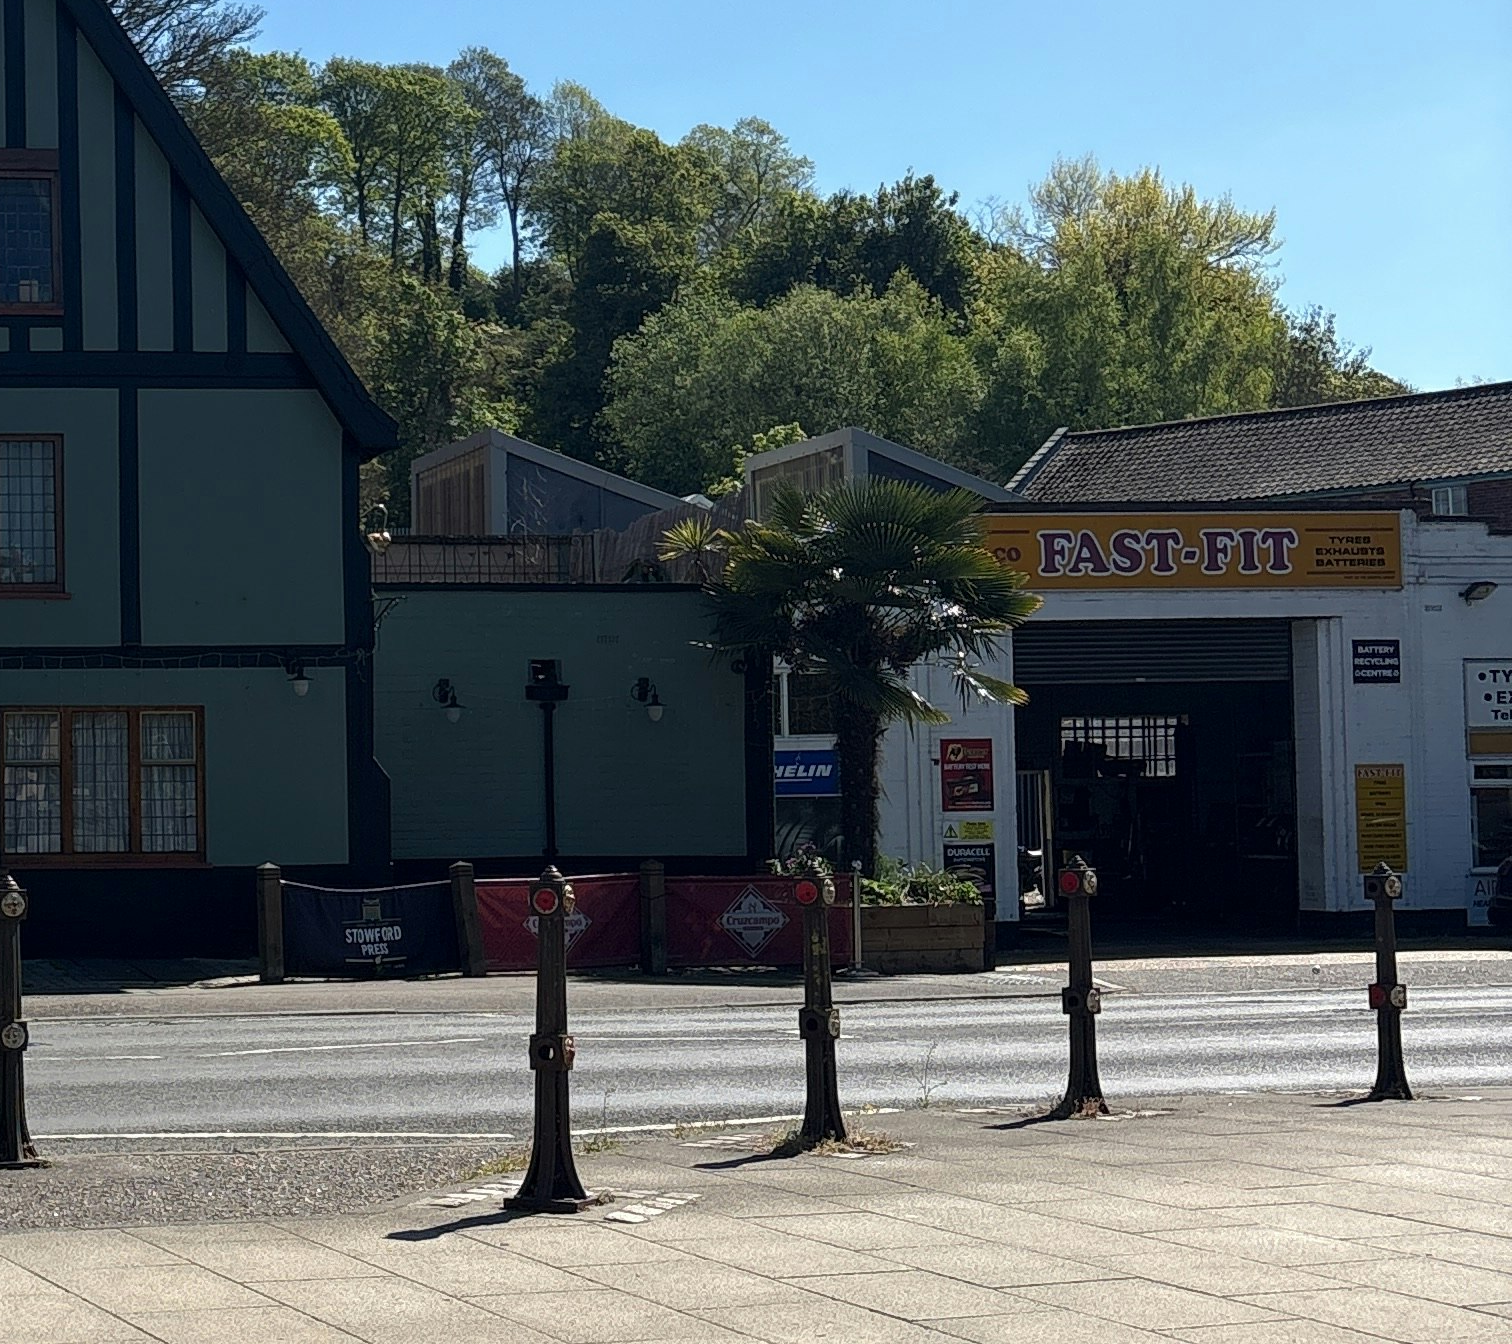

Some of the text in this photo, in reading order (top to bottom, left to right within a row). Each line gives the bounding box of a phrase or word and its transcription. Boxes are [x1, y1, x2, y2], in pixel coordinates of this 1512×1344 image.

[1329, 535, 1371, 545] TYRES
[1037, 528, 1299, 576] FAST-FIT
[1315, 546, 1385, 556] EXHAUSTS
[1315, 558, 1386, 567] BATTERIES
[1357, 645, 1395, 654] BATTERY
[1354, 657, 1399, 666] RECYCLING
[1360, 669, 1393, 677] CENTRE
[947, 847, 990, 857] DURACELL
[726, 915, 780, 926] Cruzcampo
[344, 925, 402, 944] STOWFORD
[360, 942, 389, 956] PRESS
